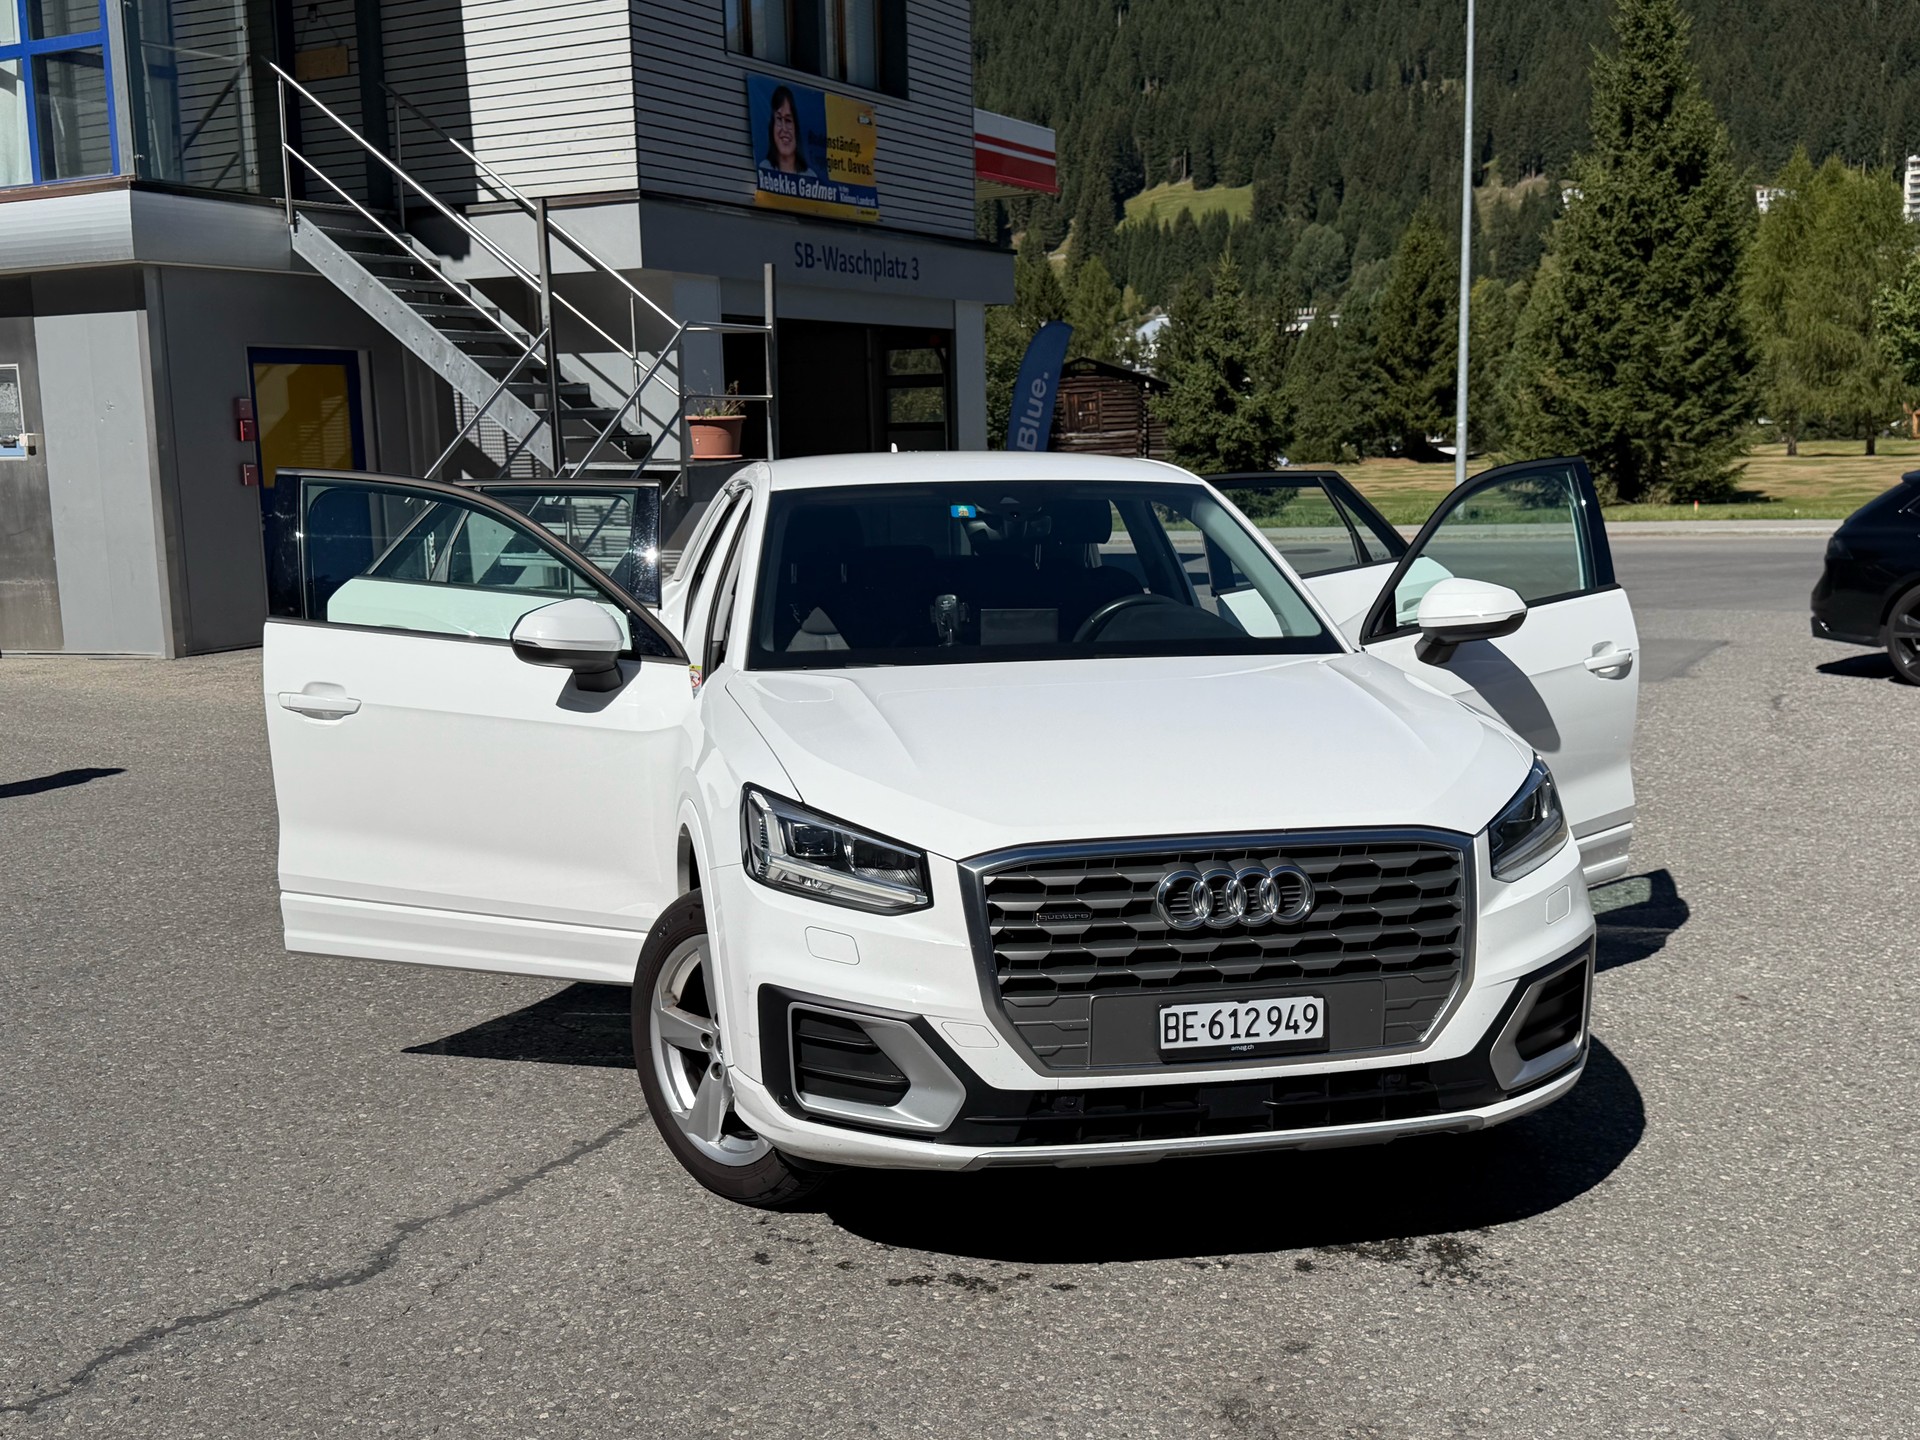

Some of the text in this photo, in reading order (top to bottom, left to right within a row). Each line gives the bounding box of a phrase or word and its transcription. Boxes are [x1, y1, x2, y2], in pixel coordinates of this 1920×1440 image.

[808, 130, 861, 157] nständig.
[847, 158, 872, 176] Davos.
[758, 169, 837, 201] Rebekka Gadmer
[794, 241, 920, 282] SB-Waschplatz 3
[1039, 913, 1089, 921] quattro
